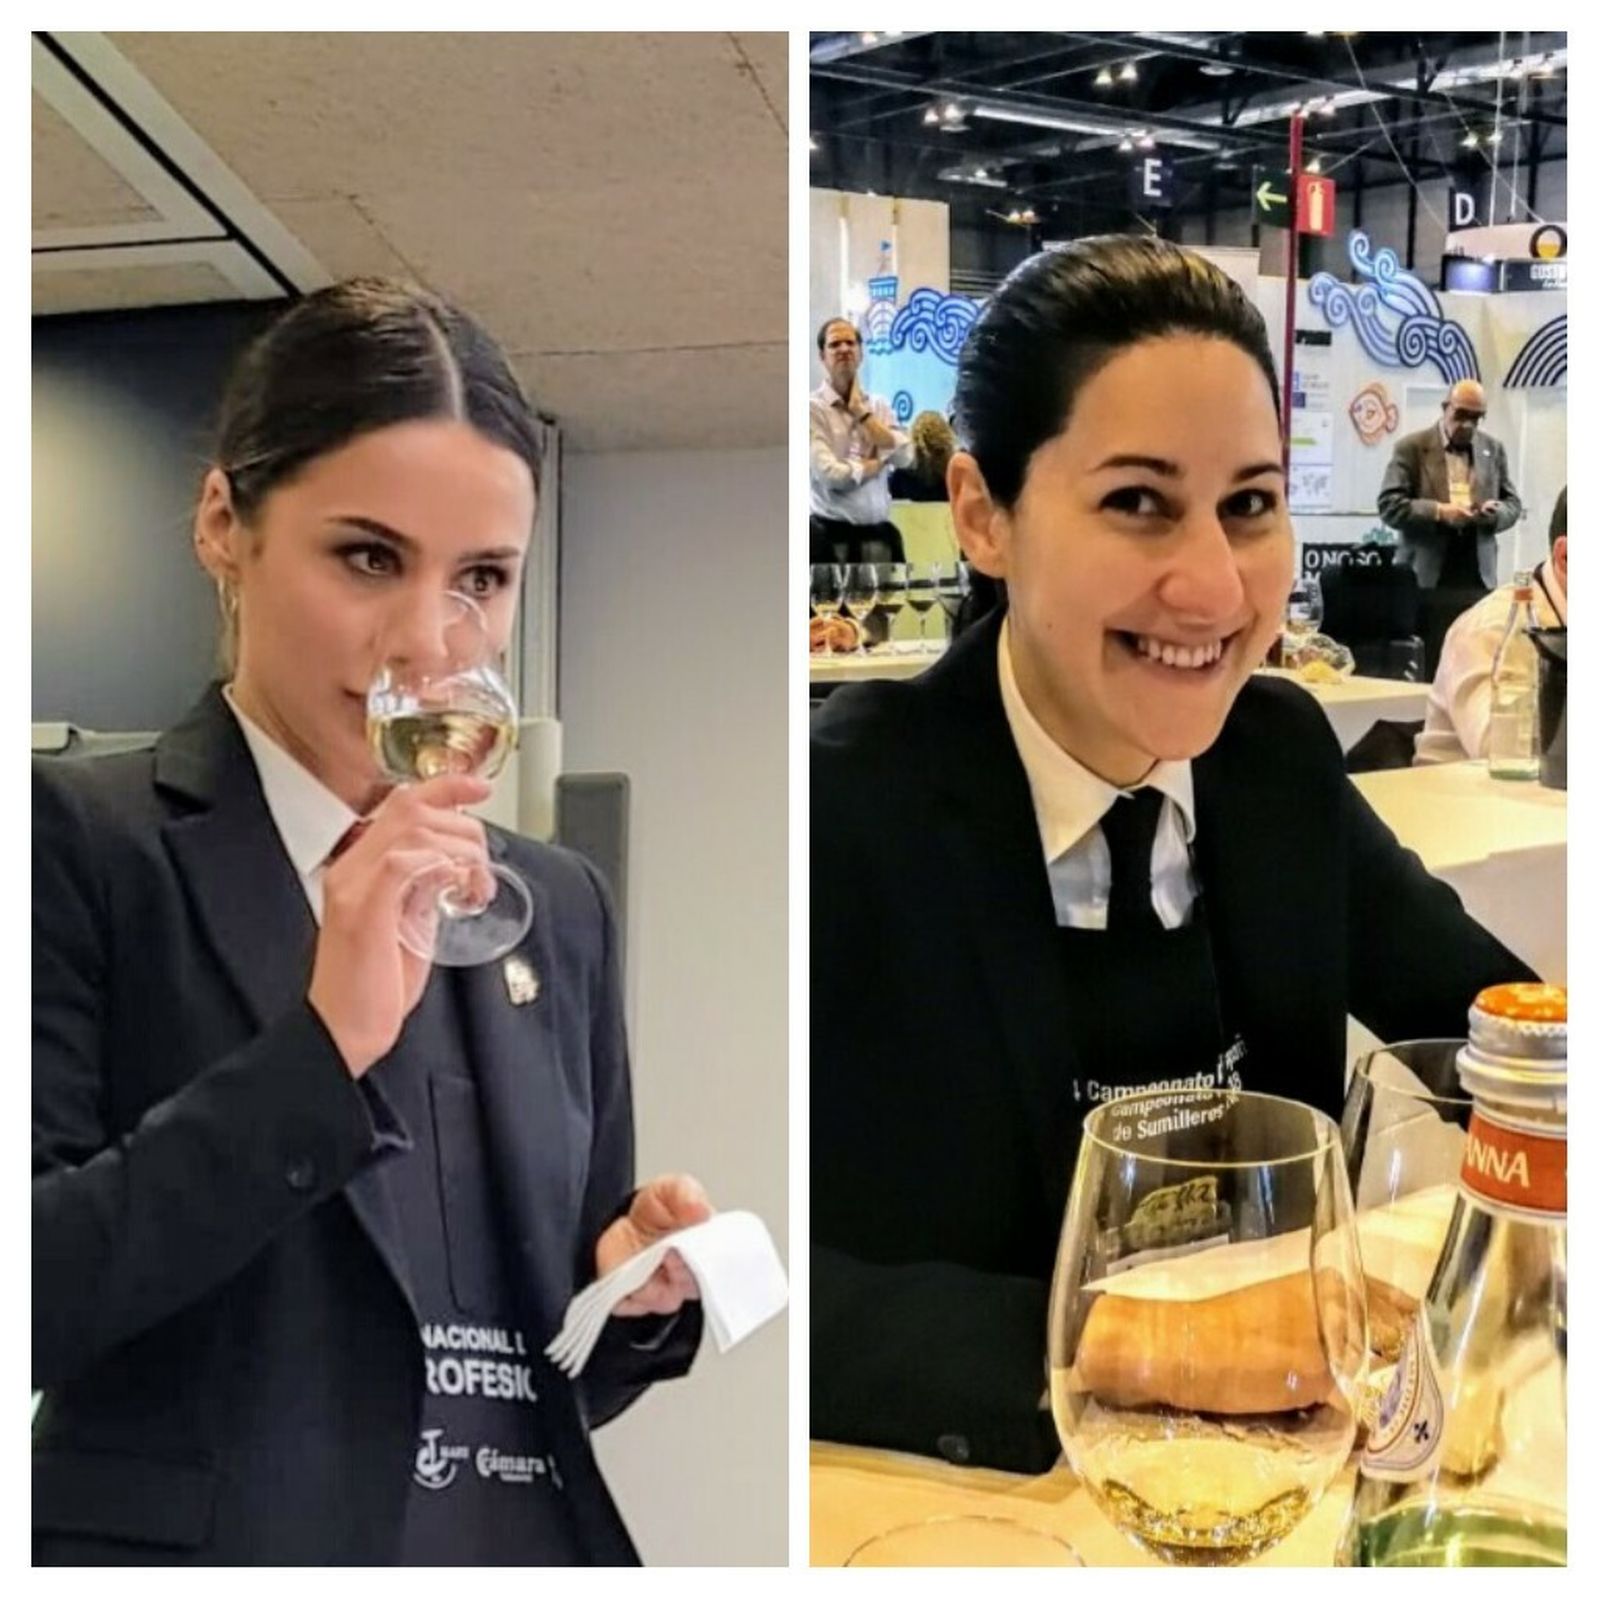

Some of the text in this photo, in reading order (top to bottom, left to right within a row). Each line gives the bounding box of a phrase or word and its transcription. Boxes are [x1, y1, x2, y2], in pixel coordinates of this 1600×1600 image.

[1144, 158, 1163, 197] E
[1455, 191, 1476, 226] D
[1136, 1102, 1226, 1141] Sumilleres
